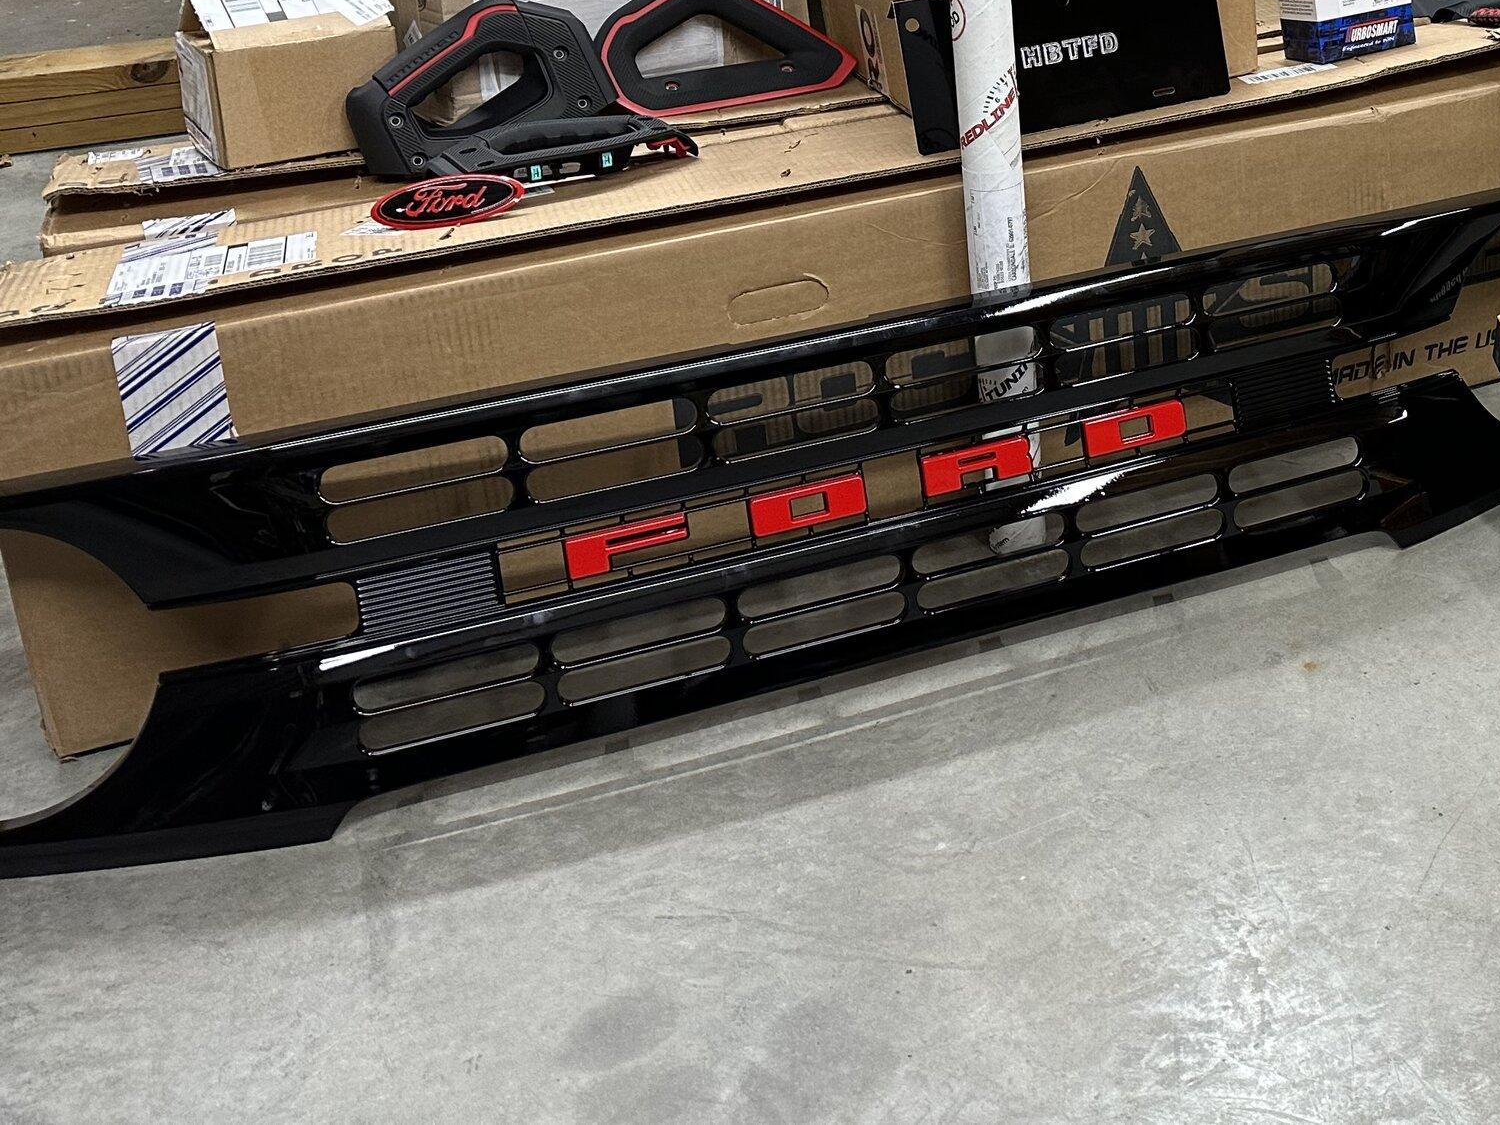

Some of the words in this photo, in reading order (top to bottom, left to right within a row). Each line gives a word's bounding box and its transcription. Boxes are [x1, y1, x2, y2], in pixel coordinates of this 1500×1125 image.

[1341, 42, 1374, 53] Engineered
[1344, 19, 1399, 44] TURBOSMART
[1020, 31, 1120, 70] HBTFD
[960, 86, 1017, 150] REDLINE
[404, 182, 488, 218] Ford
[1391, 348, 1416, 371] IN
[1424, 335, 1469, 362] THE
[984, 362, 1029, 402] TUNI
[564, 399, 1187, 580] FORD
